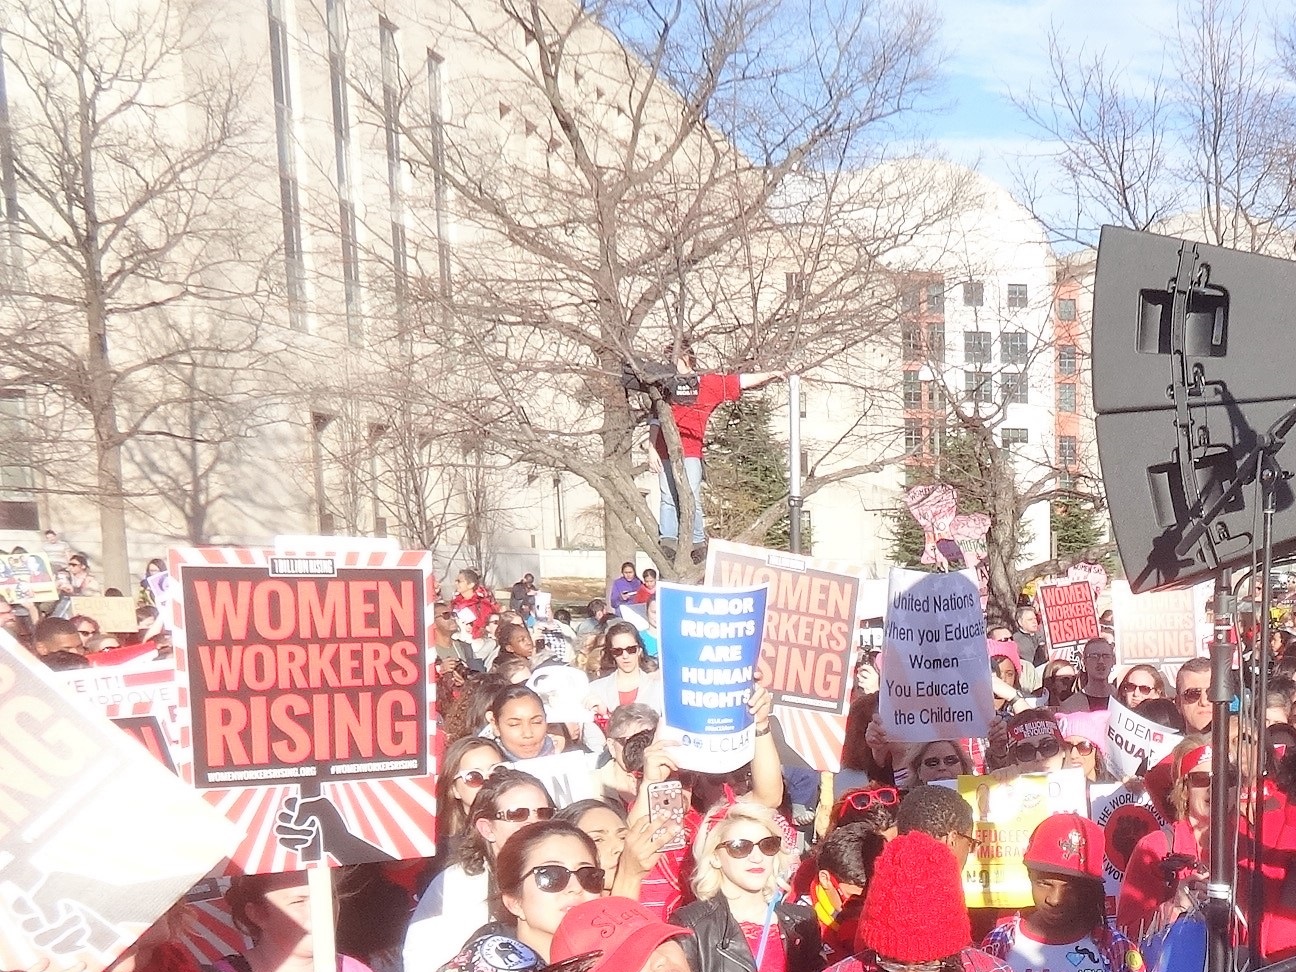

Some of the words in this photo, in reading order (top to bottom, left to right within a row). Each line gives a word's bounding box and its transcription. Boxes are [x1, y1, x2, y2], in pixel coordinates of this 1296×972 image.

[720, 560, 853, 621] WOMEN
[1041, 582, 1090, 607] WOMEN
[194, 579, 415, 641] WOMEN
[685, 596, 755, 616] LABOR
[893, 592, 930, 613] United
[933, 593, 975, 614] Nations
[1045, 601, 1095, 622] WORKERS
[680, 619, 756, 640] RIGHTS
[764, 610, 849, 651] RKERS
[917, 629, 941, 646] you
[1049, 616, 1097, 644] RISING
[699, 644, 743, 663] ARE
[1122, 629, 1195, 658] RISING
[198, 640, 419, 692] WORKERS
[757, 641, 842, 699] SING
[909, 654, 960, 670] Women
[681, 665, 753, 686] HUMAN
[681, 688, 751, 709] RIGHTS
[886, 679, 912, 698] You
[916, 680, 970, 697] Educate
[894, 709, 916, 726] the
[919, 706, 974, 725] Children
[204, 689, 418, 767] RISING
[1097, 806, 1112, 827] THE
[976, 829, 1029, 844] EFUGEES
